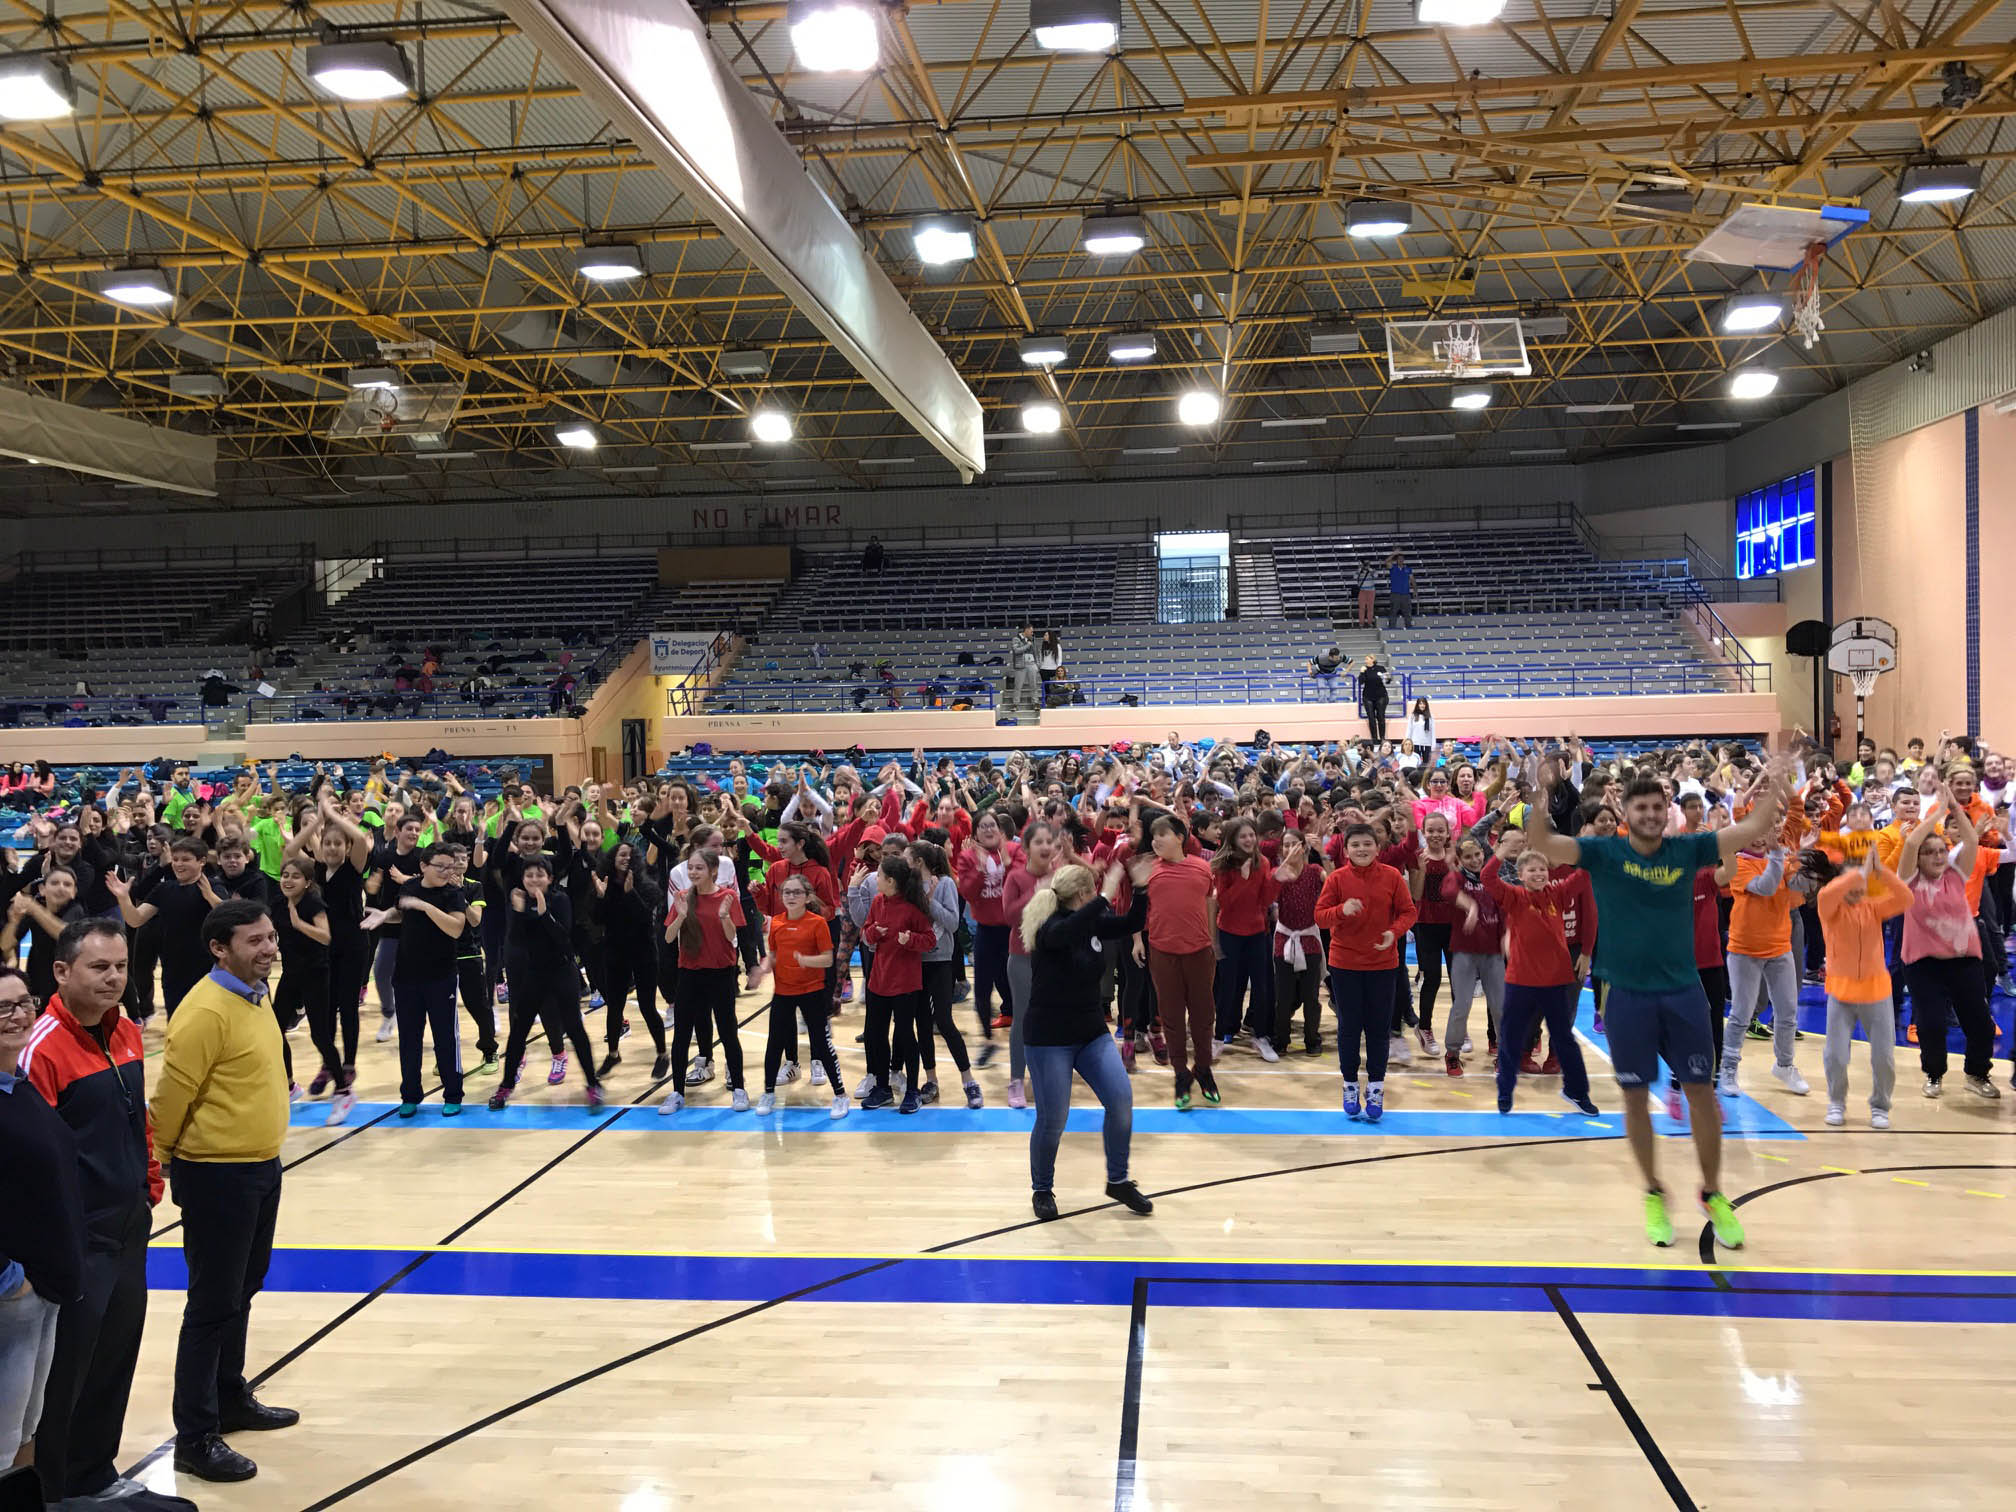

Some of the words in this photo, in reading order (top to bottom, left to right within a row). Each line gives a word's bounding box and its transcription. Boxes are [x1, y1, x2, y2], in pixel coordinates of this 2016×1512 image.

[692, 508, 729, 529] NO
[743, 504, 841, 529] FUMAR
[708, 720, 741, 728] PRENSA
[444, 726, 477, 734] PRENSA
